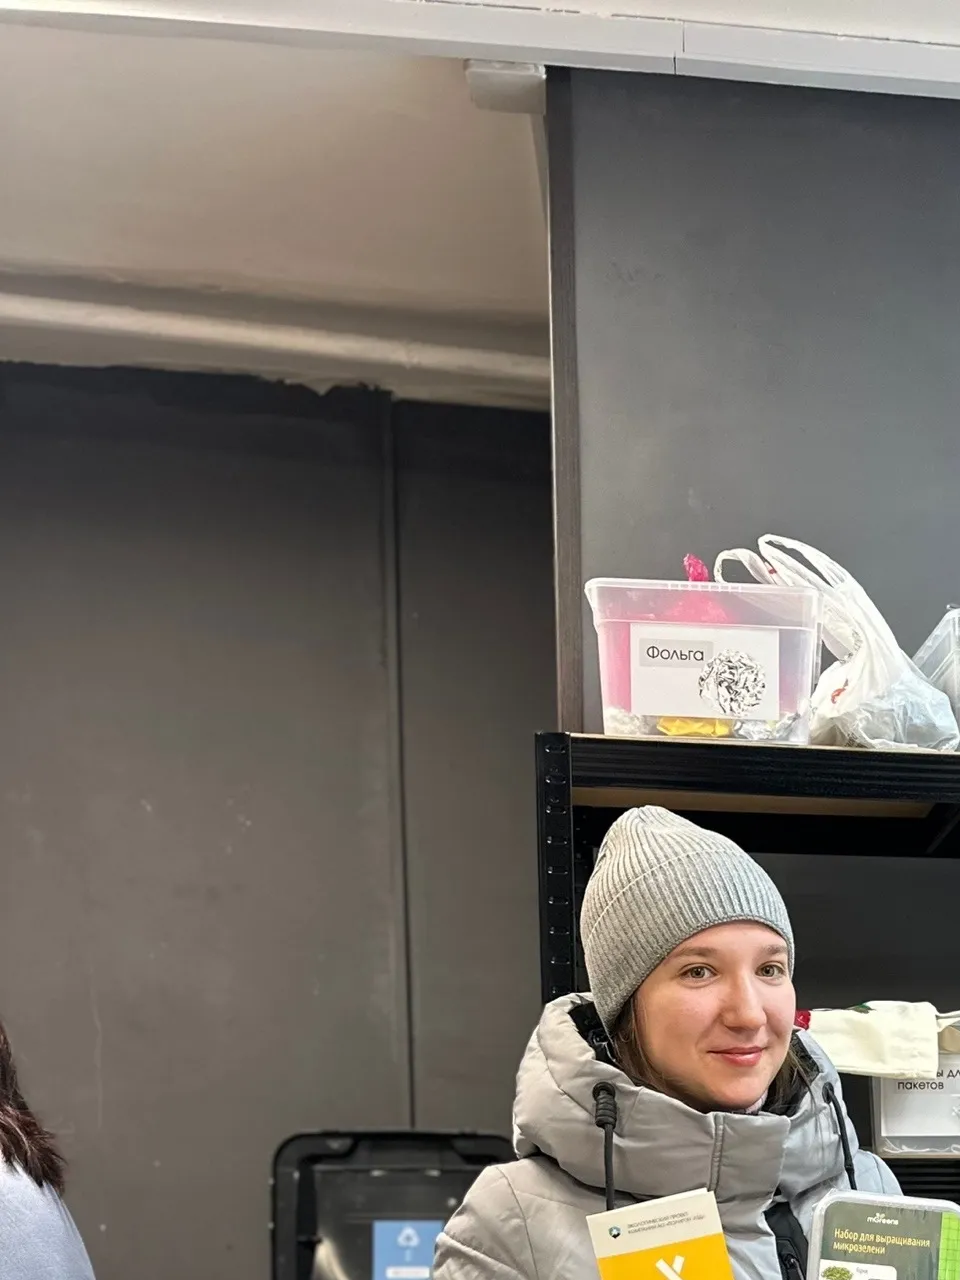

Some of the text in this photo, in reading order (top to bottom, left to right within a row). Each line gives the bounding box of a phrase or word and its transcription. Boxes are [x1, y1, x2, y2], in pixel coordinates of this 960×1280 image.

[646, 645, 704, 661] Фольга
[897, 1081, 944, 1090] пакетов
[834, 1228, 931, 1247] Набор для выращивания
[833, 1241, 886, 1254] микрозелени
